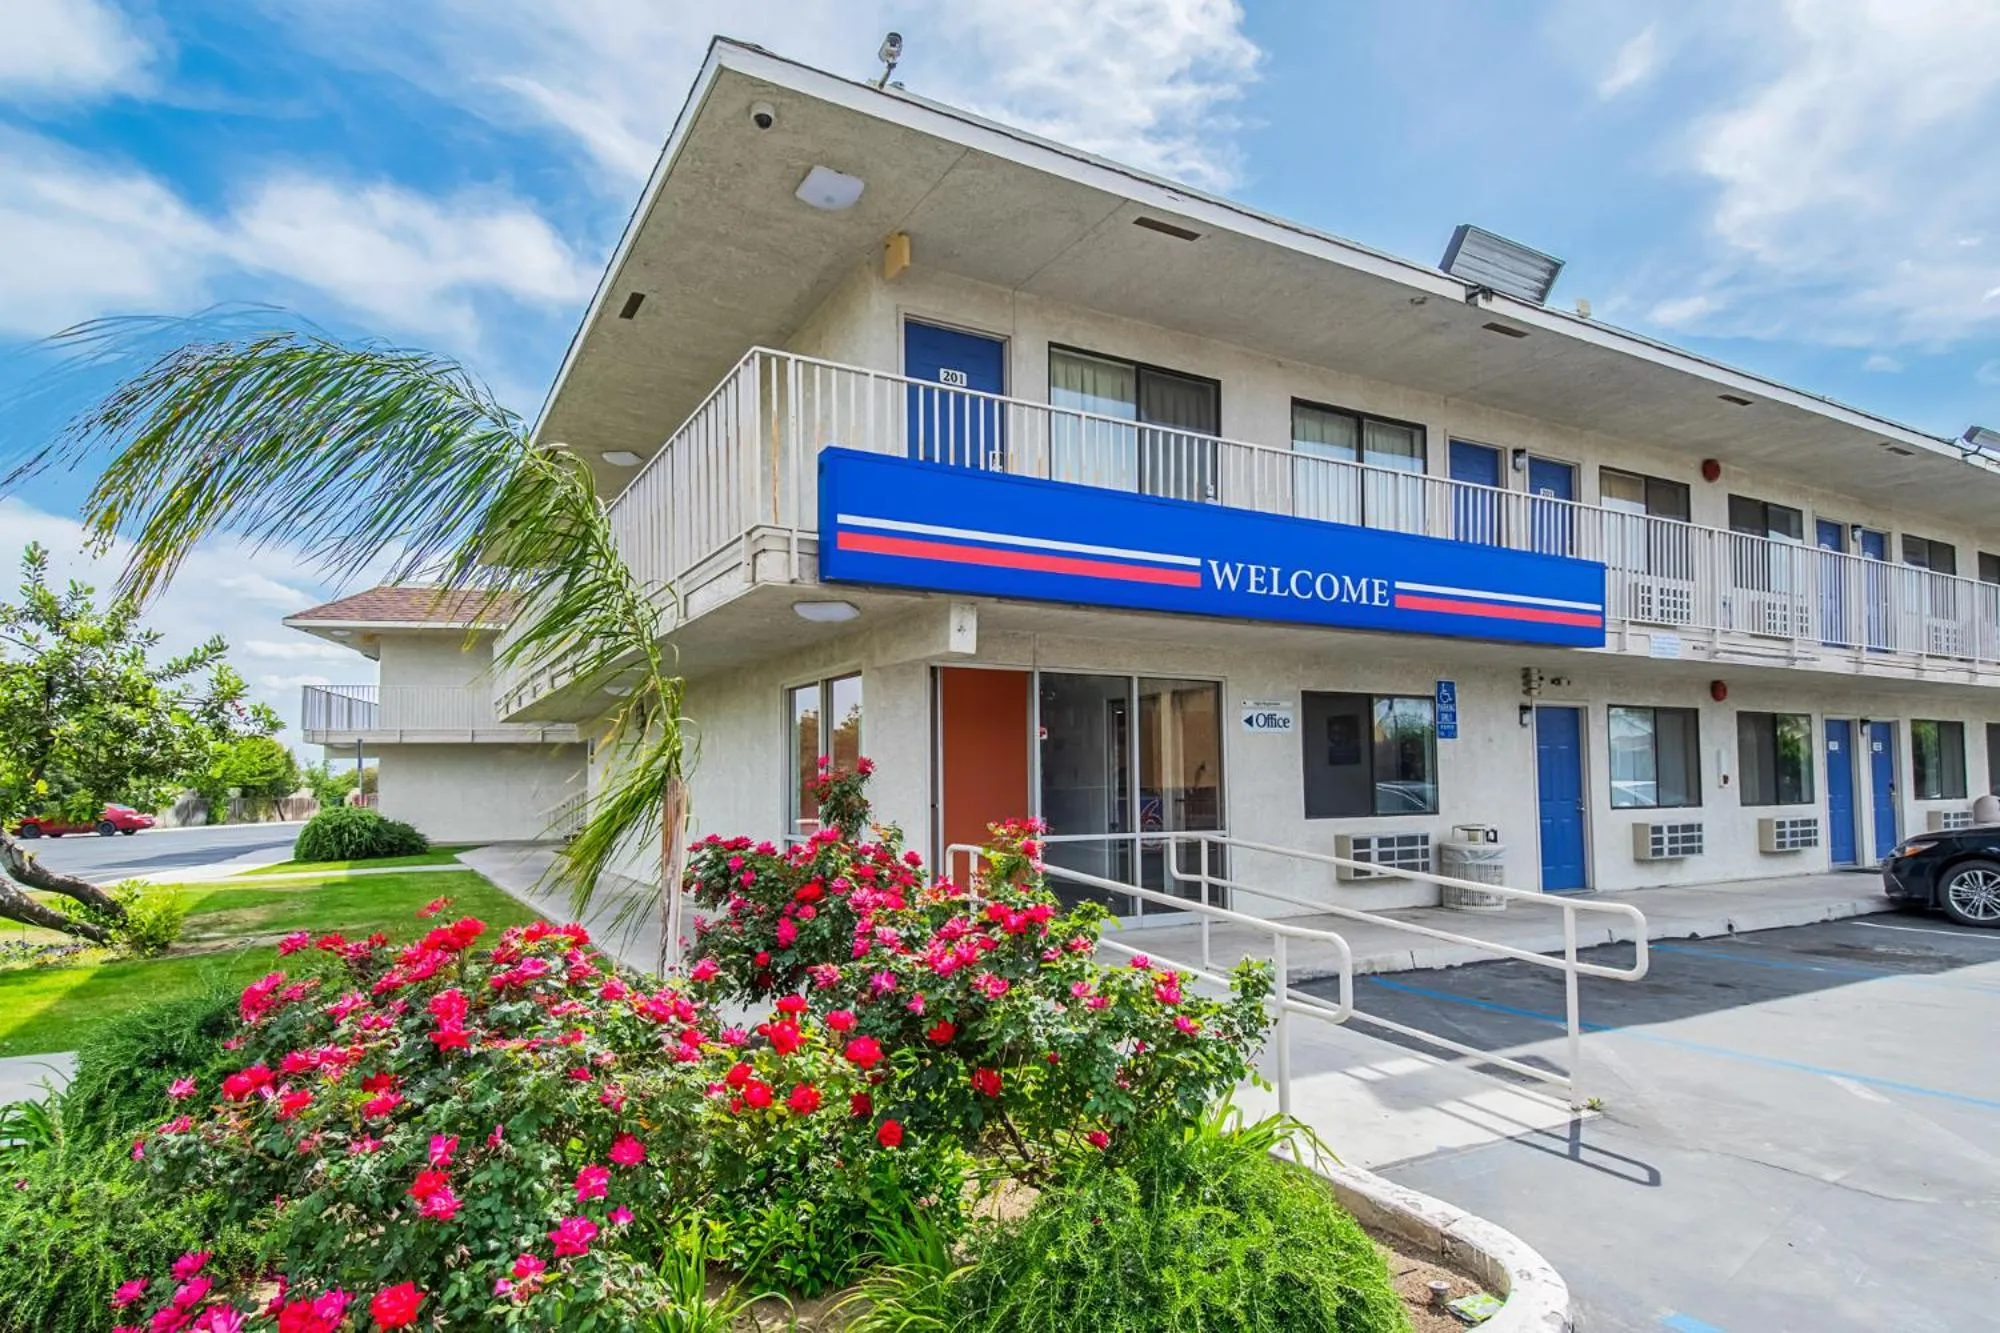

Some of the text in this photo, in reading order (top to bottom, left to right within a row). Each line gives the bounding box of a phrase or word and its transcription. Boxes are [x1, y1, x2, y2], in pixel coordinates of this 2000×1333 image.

[943, 371, 963, 384] 201
[1207, 559, 1390, 607] WELCOME
[1255, 712, 1291, 728] Office
